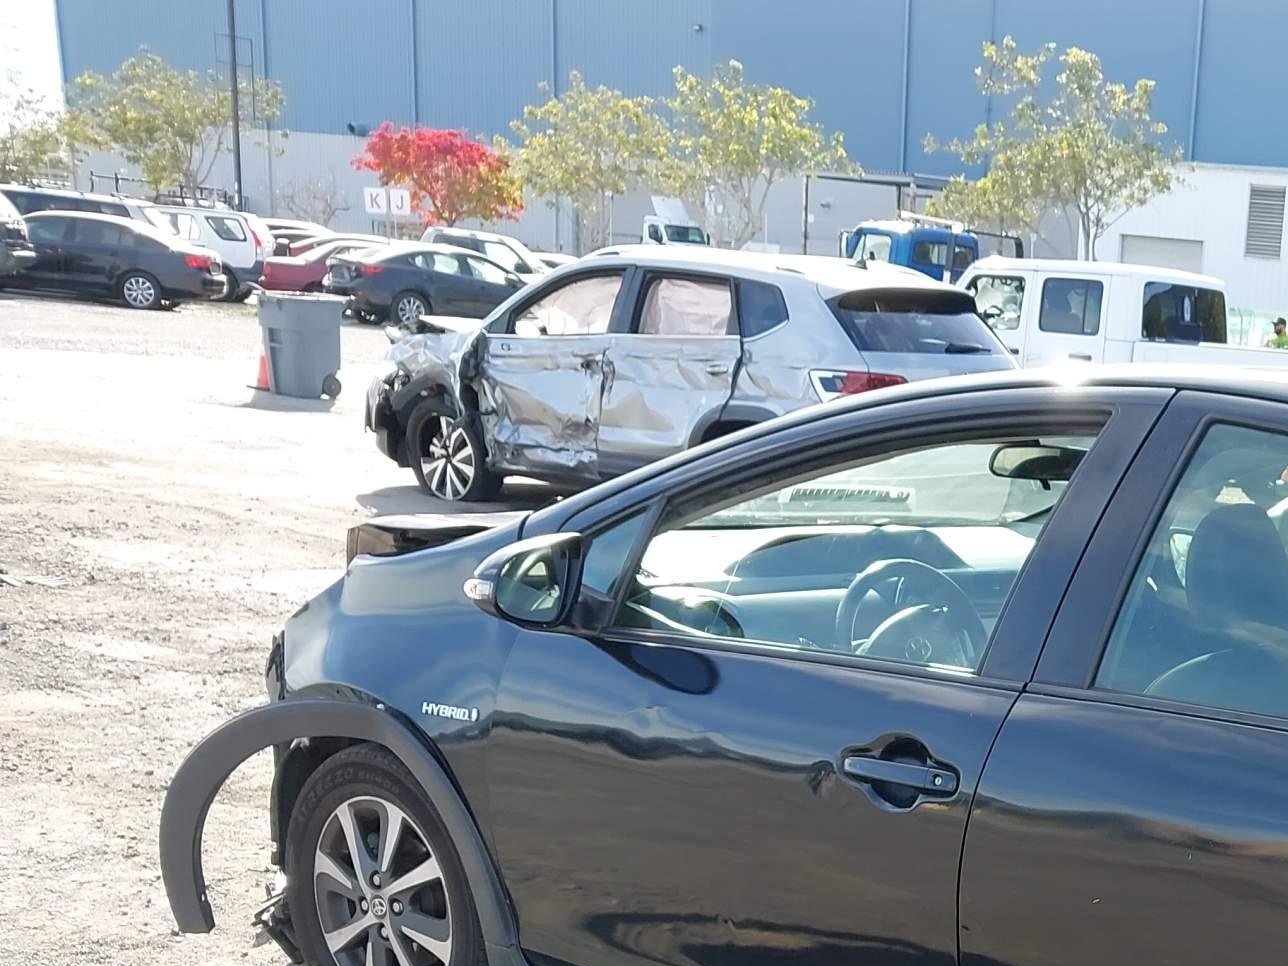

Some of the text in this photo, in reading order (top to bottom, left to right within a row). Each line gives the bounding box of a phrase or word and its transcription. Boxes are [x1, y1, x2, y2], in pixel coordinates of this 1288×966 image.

[370, 193, 381, 209] K
[396, 195, 404, 210] J
[421, 701, 468, 720] HYBRID
